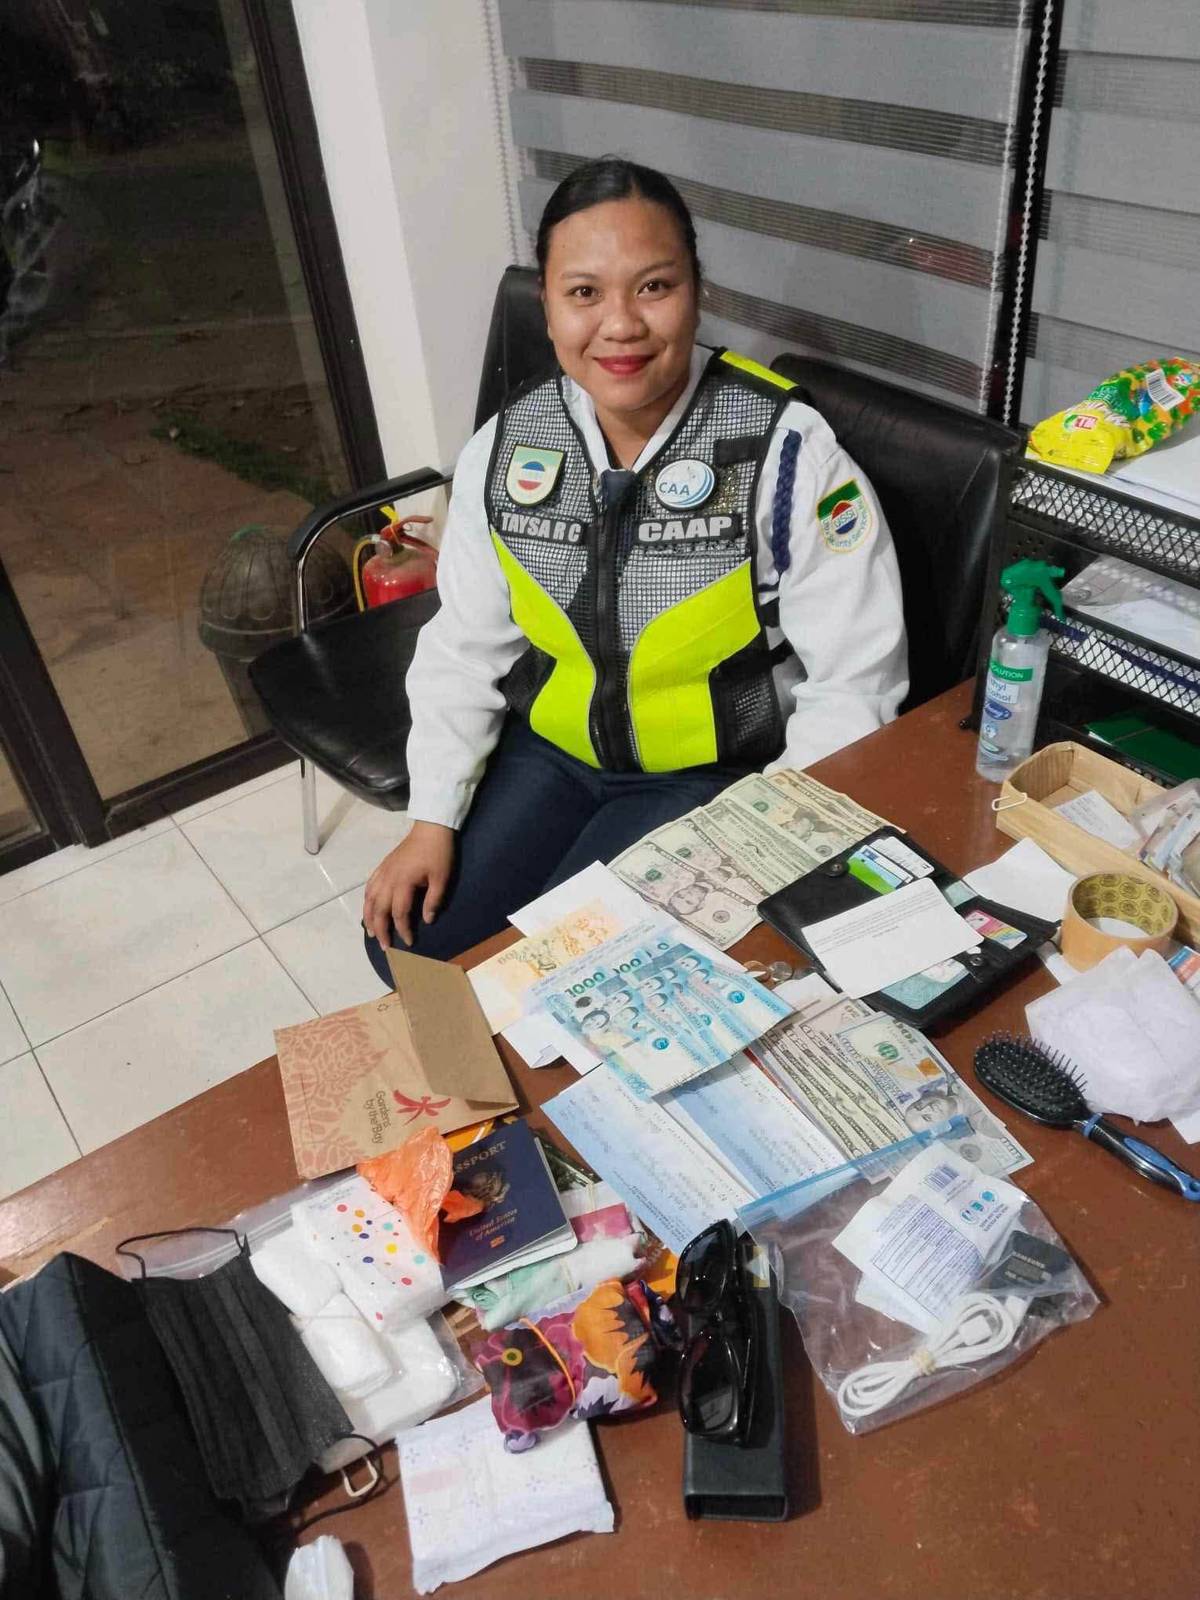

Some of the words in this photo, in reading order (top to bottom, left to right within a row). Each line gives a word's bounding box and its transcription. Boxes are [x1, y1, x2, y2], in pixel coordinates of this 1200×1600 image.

[501, 512, 551, 538] TAYSA
[553, 521, 567, 540] R
[568, 522, 582, 543] C
[638, 516, 733, 541] CAAP
[564, 971, 606, 998] 1000
[455, 1140, 508, 1174] SSPORT
